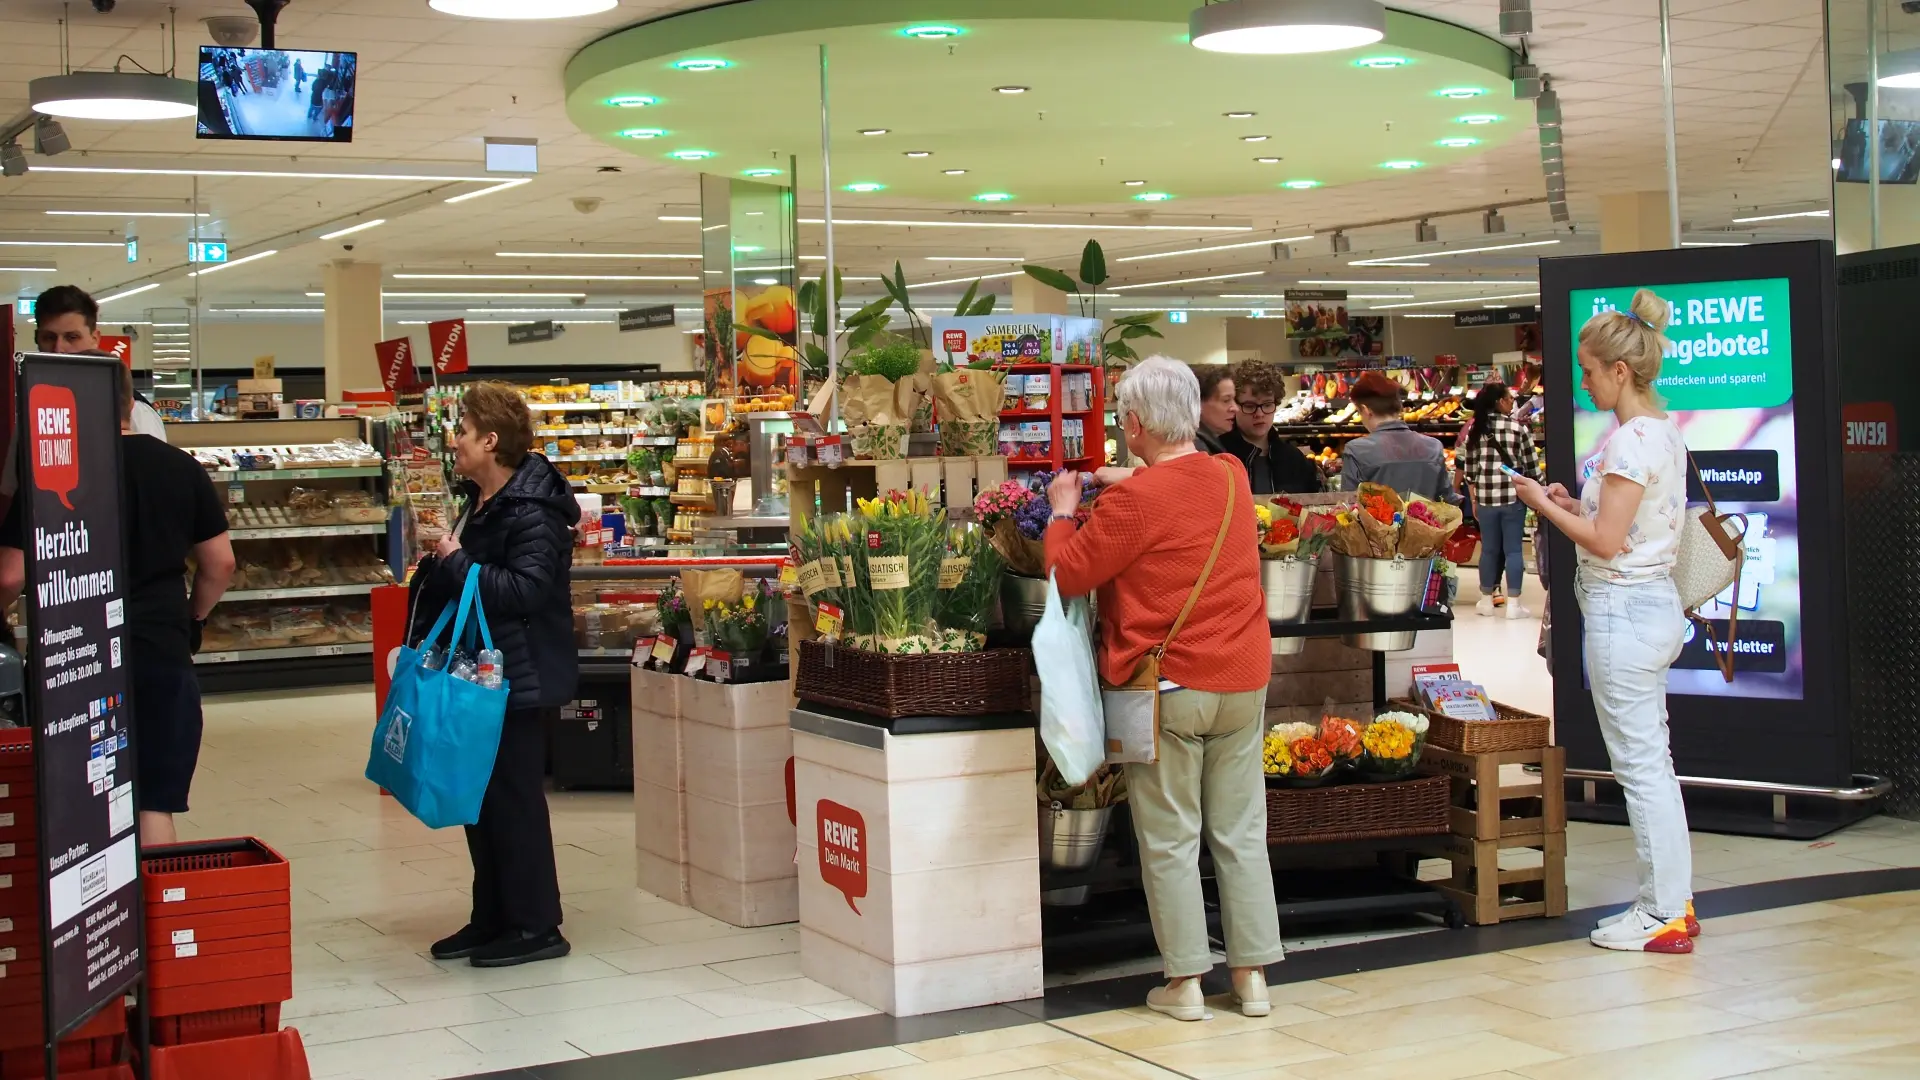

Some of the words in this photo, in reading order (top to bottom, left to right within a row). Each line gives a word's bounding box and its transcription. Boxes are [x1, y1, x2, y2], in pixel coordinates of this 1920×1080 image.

[1687, 296, 1765, 325] REWE
[437, 323, 463, 372] AKTION
[386, 342, 408, 389] AKTION
[1656, 374, 1706, 386] entdecken
[1708, 373, 1727, 385] und
[1729, 372, 1766, 386] sparen!
[38, 408, 71, 435] REWE
[39, 439, 53, 467] DEIN
[54, 438, 72, 466] MARKT
[1699, 469, 1762, 485] WhatsApp
[35, 520, 89, 561] Herzlich
[37, 569, 114, 609] willkommen
[44, 624, 84, 646] Öffnungszeiten:
[45, 652, 67, 668] montags
[67, 646, 75, 661] bis
[75, 643, 98, 659] samstags
[46, 677, 57, 690] von
[56, 671, 69, 688] 7.00
[69, 667, 77, 683] bis
[77, 663, 93, 680] 20.00
[93, 660, 102, 675] Uhr
[48, 722, 58, 737] Wir
[58, 713, 89, 734] akzeptieren:
[823, 818, 860, 853] REWE
[50, 852, 68, 872] Unsere
[68, 842, 89, 862] Partner:
[824, 847, 840, 867] Dein
[840, 852, 860, 875] Markt
[53, 924, 80, 949] www.rewe.de
